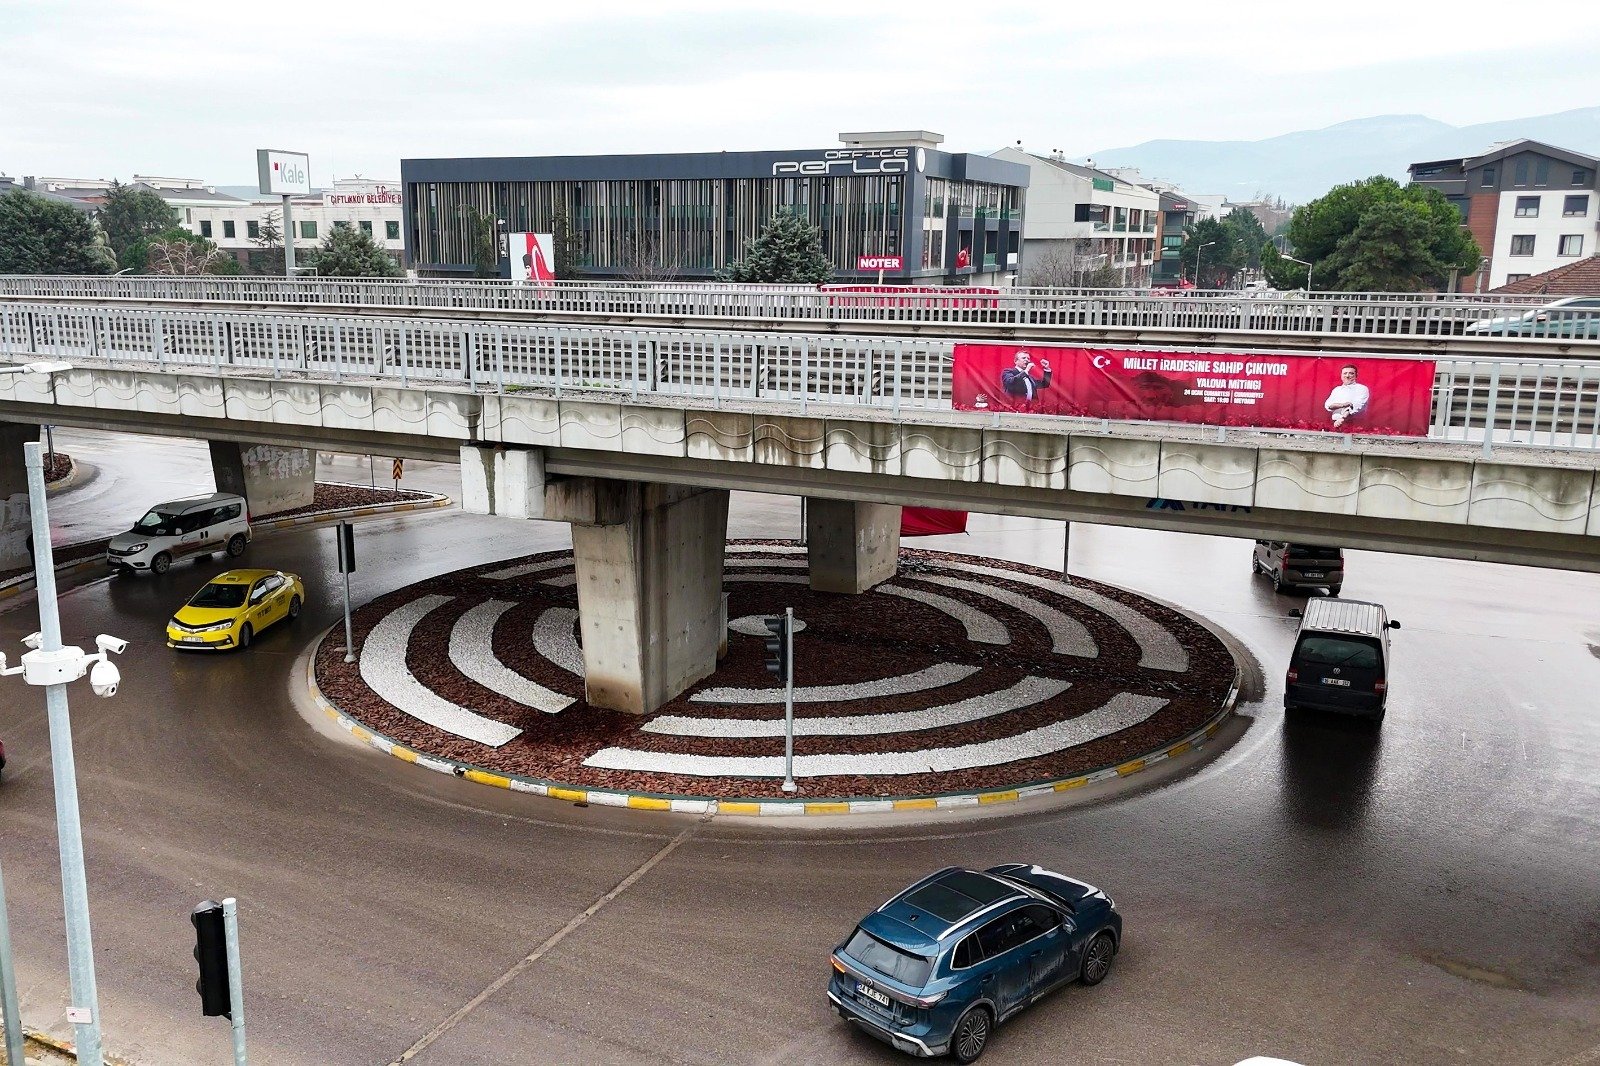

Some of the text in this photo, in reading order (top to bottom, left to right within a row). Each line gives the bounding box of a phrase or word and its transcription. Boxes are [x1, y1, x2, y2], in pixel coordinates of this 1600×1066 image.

[280, 163, 305, 184] Kale
[860, 257, 900, 268] NOTER
[1245, 362, 1288, 377] ÇIKIYOR
[1197, 378, 1226, 388] YALOVA
